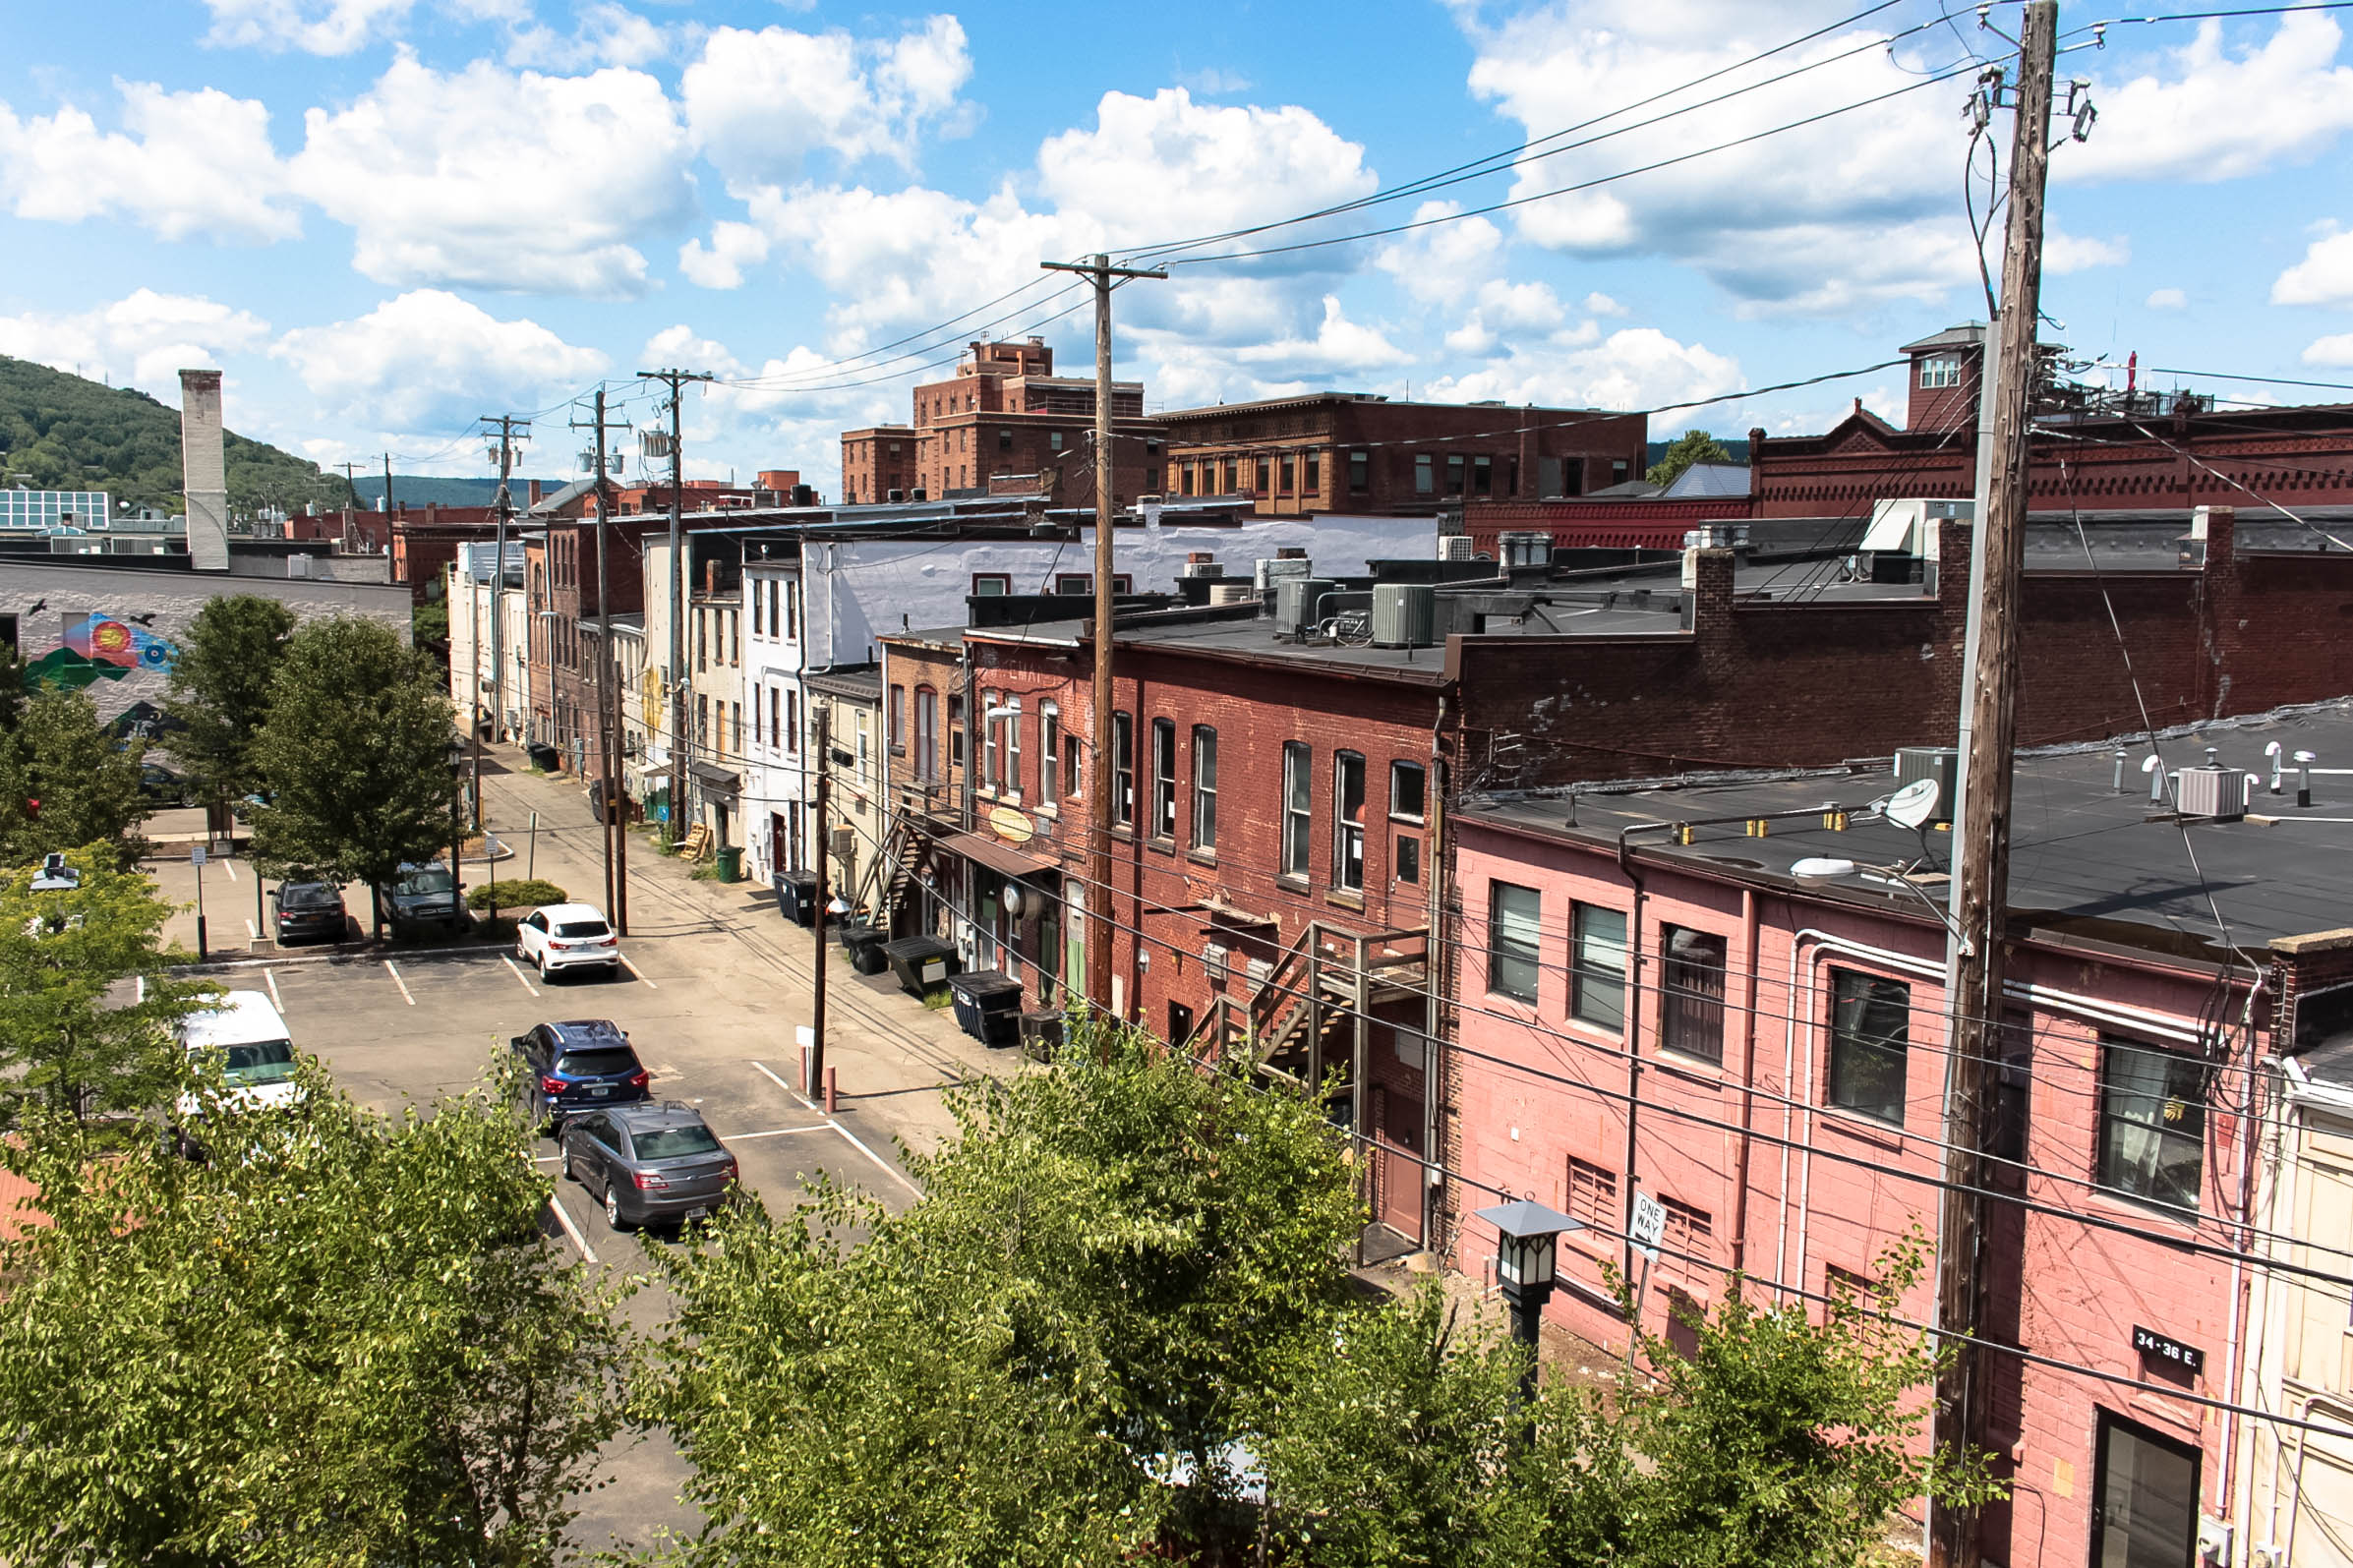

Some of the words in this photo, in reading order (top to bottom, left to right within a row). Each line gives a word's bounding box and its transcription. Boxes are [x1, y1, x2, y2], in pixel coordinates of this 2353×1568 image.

[1640, 1198, 1661, 1222] ONE
[1637, 1212, 1659, 1236] WAY
[2184, 1350, 2197, 1367] E.
